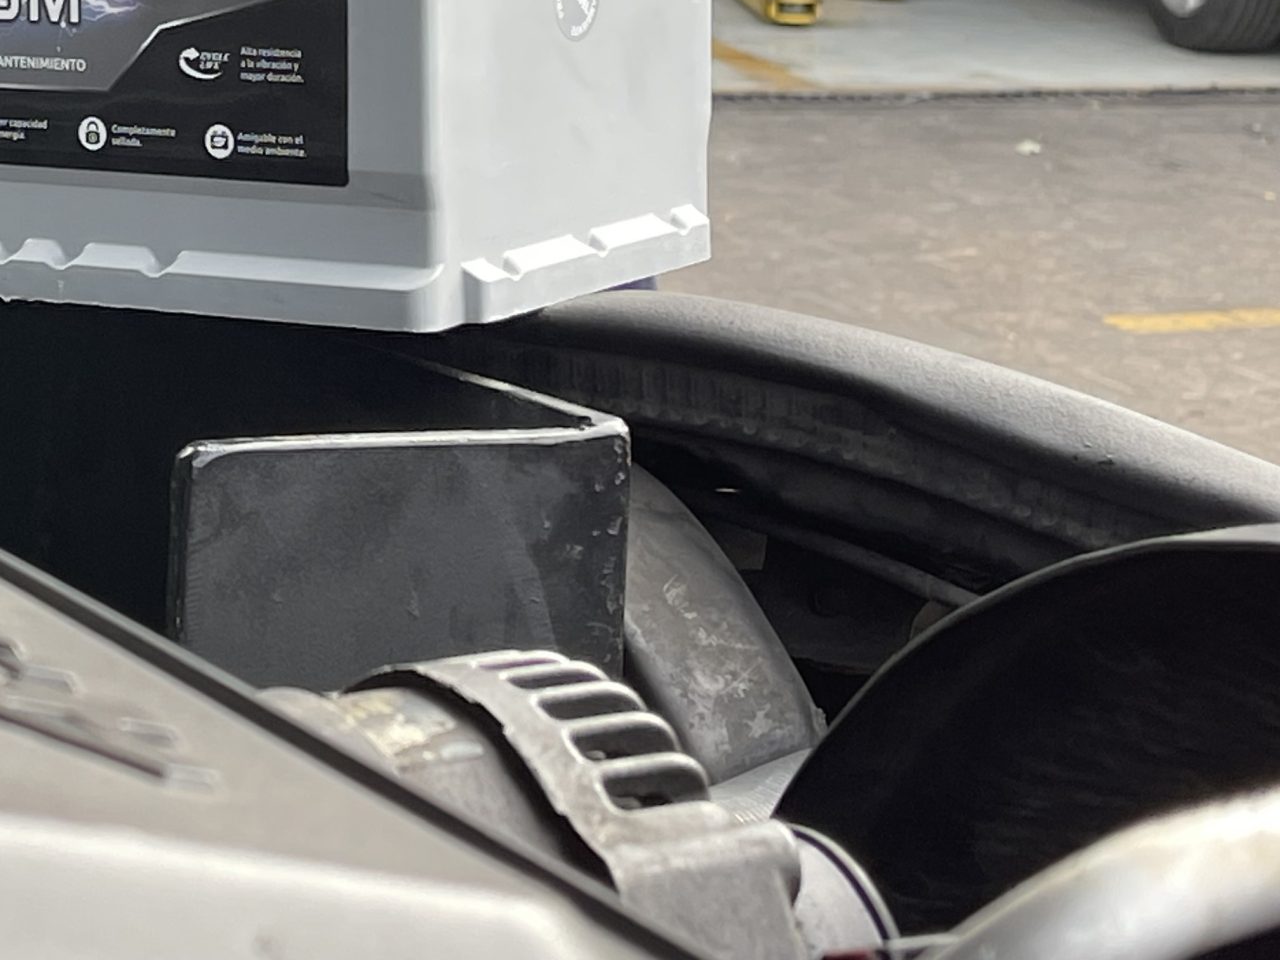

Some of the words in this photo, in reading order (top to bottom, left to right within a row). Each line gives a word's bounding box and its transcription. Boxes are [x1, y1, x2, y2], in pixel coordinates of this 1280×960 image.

[240, 46, 258, 57] Alta
[111, 124, 176, 138] Completamente
[277, 136, 294, 144] con
[294, 135, 304, 145] el
